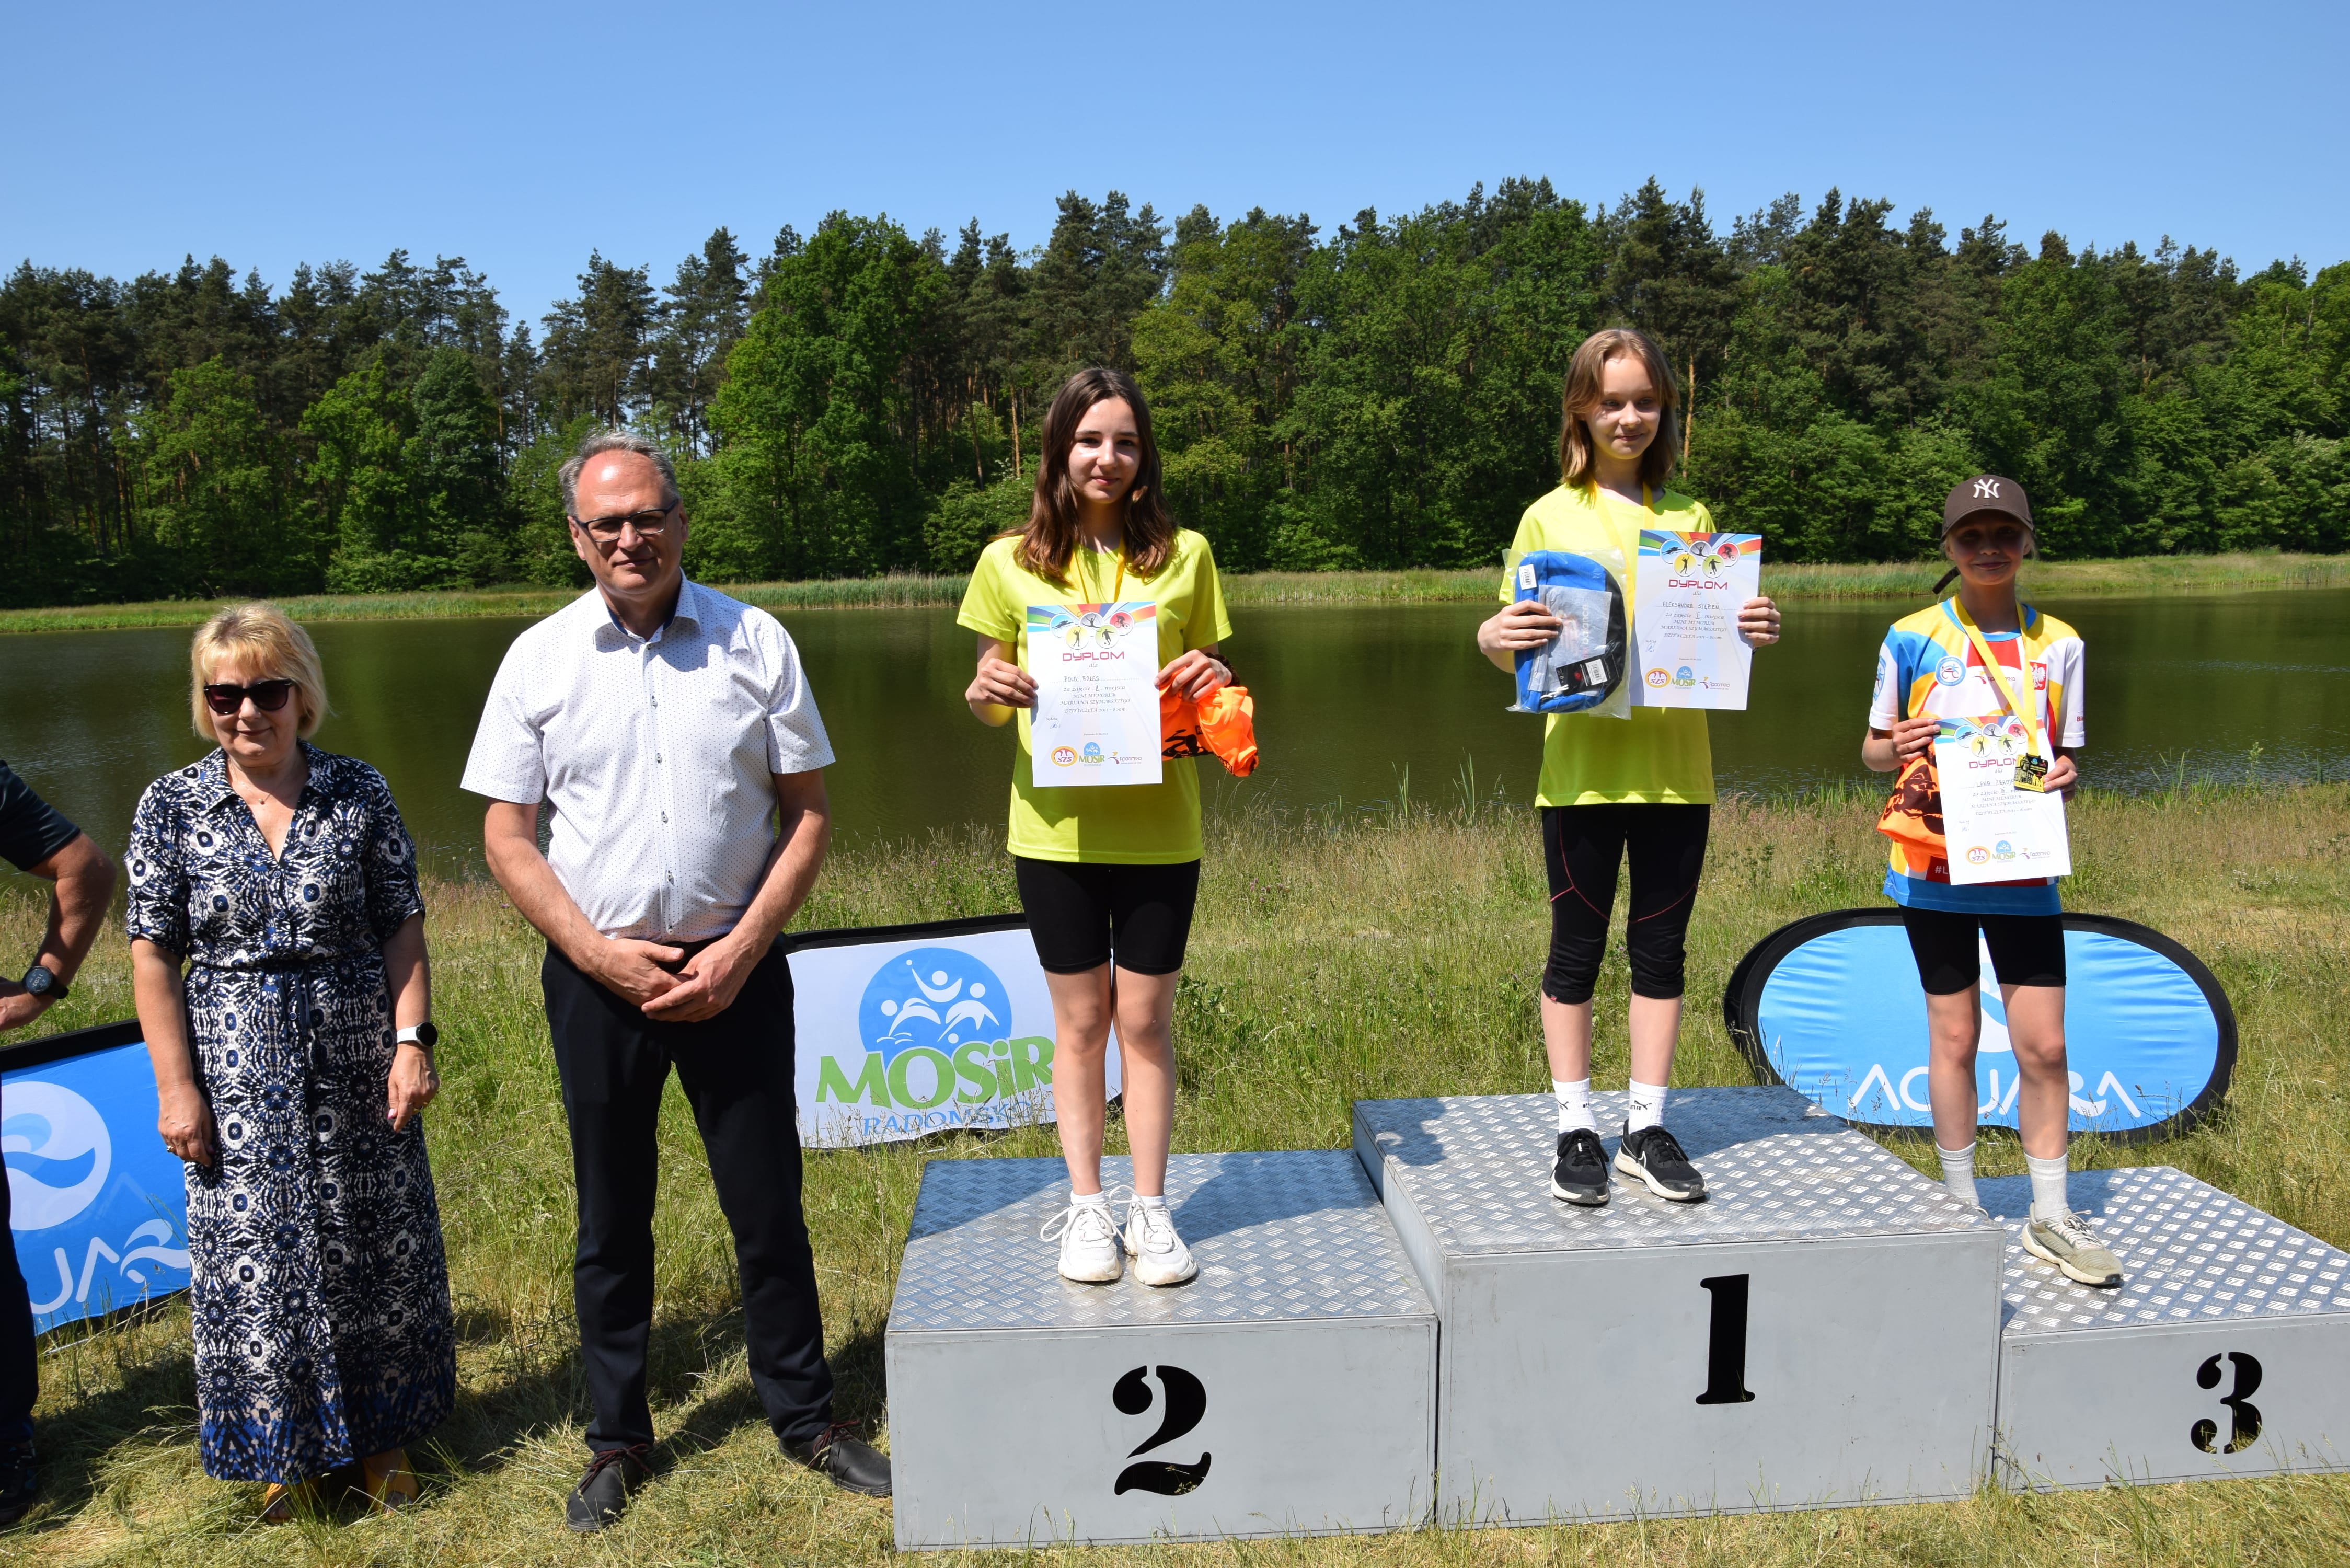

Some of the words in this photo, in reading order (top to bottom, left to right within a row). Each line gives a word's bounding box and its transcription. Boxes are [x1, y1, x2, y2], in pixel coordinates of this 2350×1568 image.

[1668, 579, 1727, 590] DYPLOM
[1063, 651, 1124, 661] DYPLOM
[1094, 683, 1100, 691] II
[1079, 755, 1105, 763] MOSiR
[1992, 851, 2016, 860] MOSiR
[815, 1036, 1055, 1109] MOSiR
[863, 1101, 1032, 1136] RADOMSKO
[1696, 1274, 1755, 1404] 1
[2191, 1352, 2262, 1453] 3
[1113, 1366, 1211, 1495] 2
